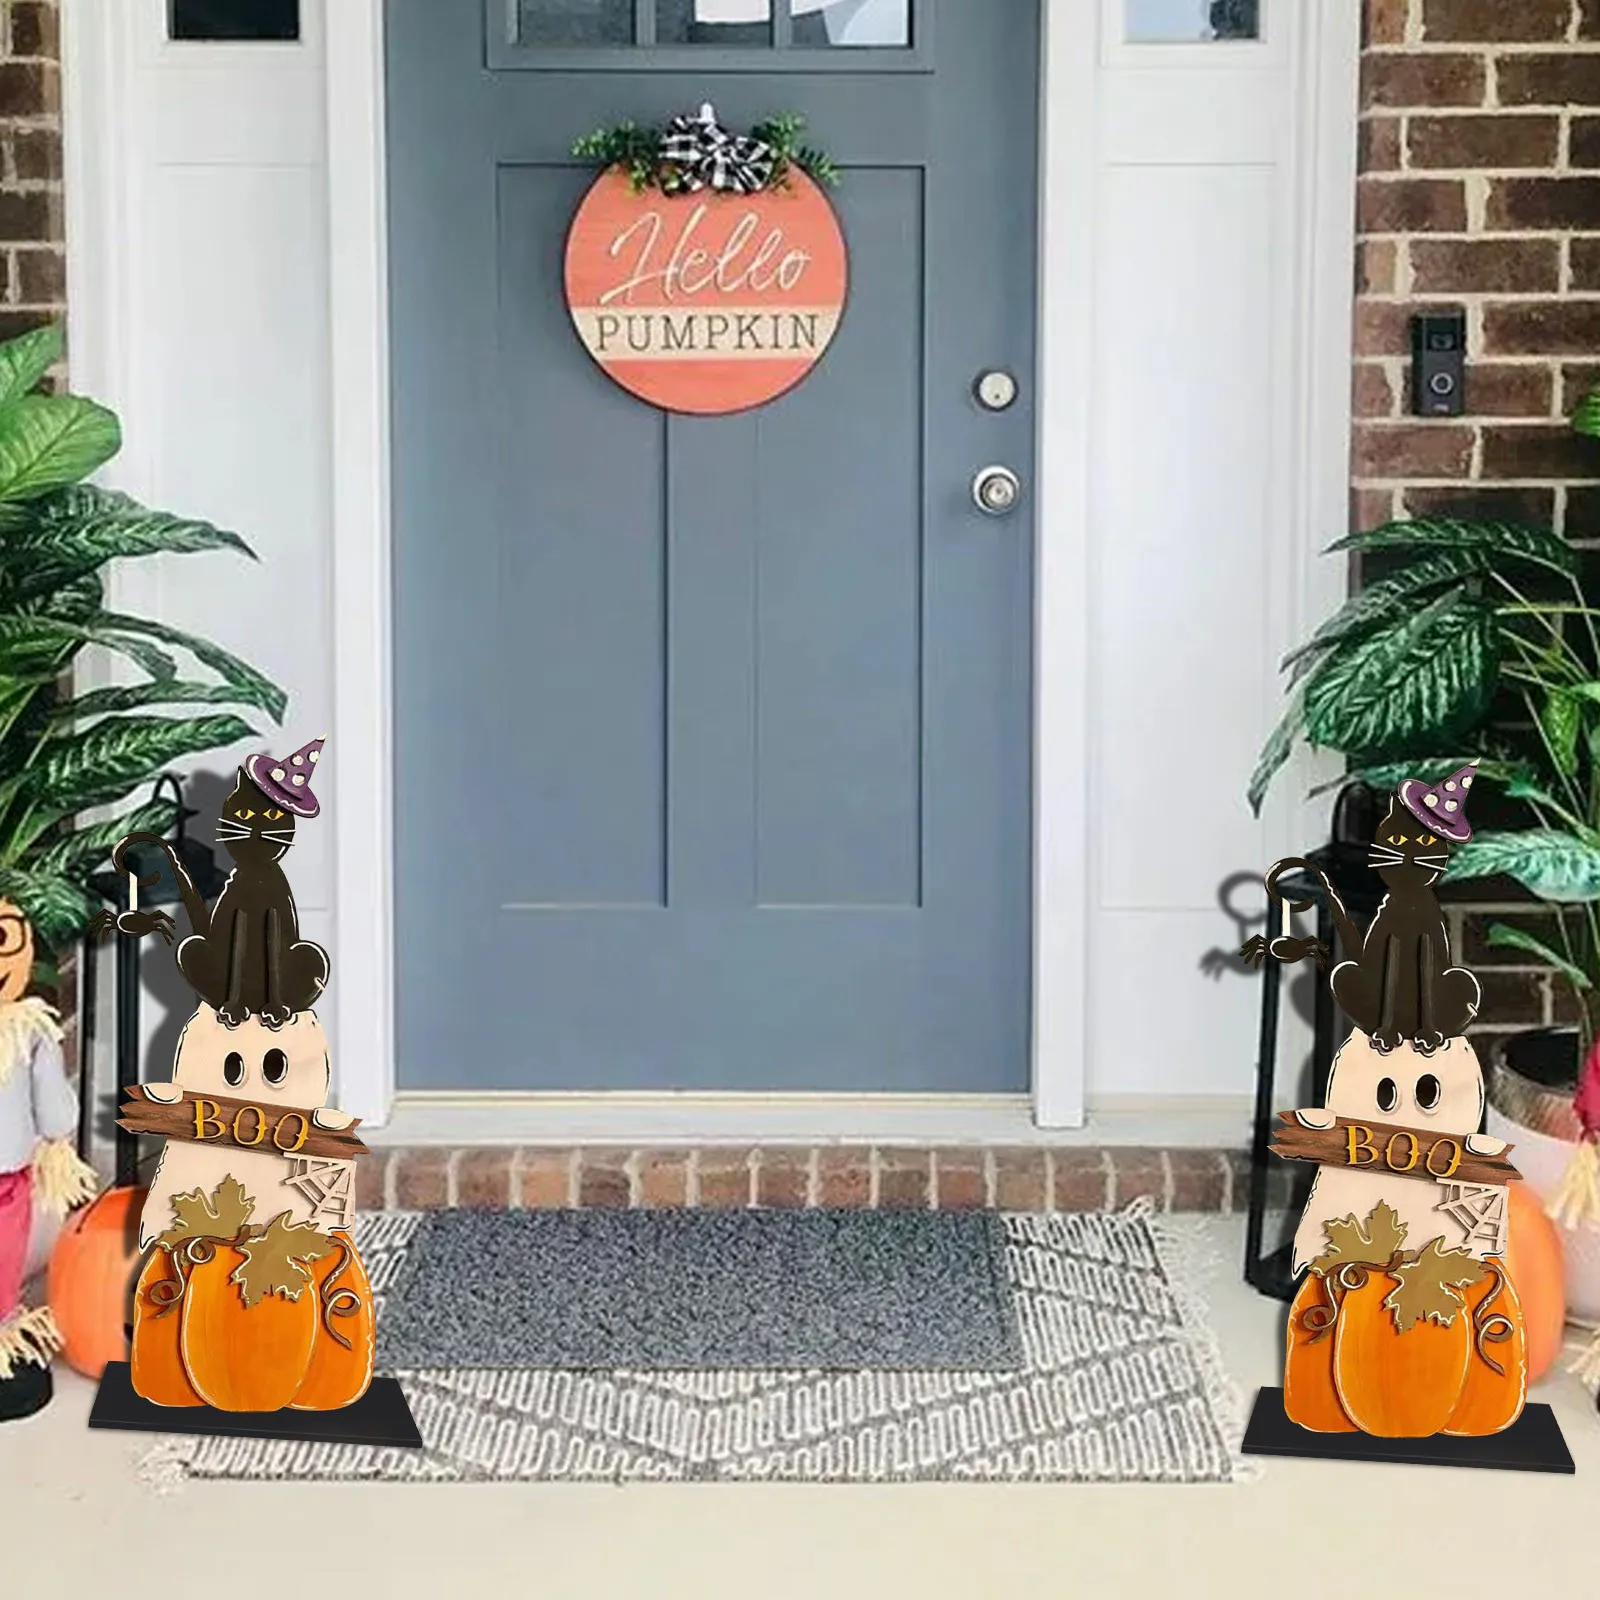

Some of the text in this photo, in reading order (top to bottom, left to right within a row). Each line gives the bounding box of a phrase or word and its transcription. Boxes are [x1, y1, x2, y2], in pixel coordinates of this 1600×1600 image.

[599, 203, 812, 305] Hello
[594, 313, 820, 352] PUMPKIN
[190, 1099, 309, 1152] BOO
[1344, 1125, 1463, 1178] BOO
